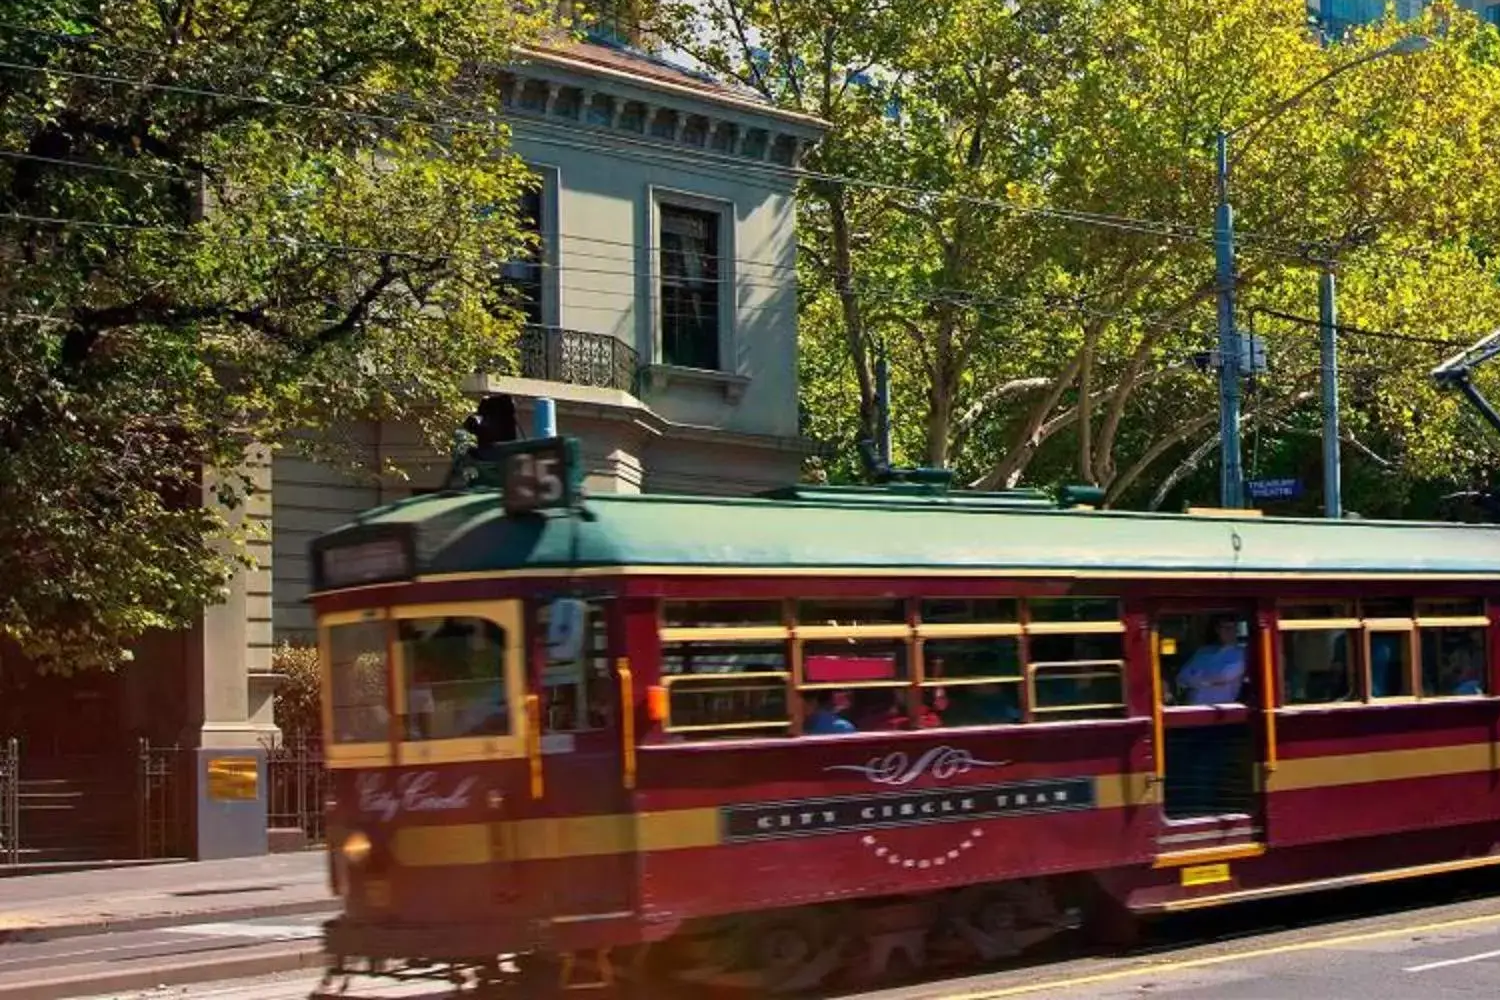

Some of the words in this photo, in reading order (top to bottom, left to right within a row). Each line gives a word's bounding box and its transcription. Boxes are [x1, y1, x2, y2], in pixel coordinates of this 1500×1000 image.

[757, 809, 837, 830] CITY
[861, 797, 976, 819] CIRCLE
[997, 790, 1069, 808] TRAM
